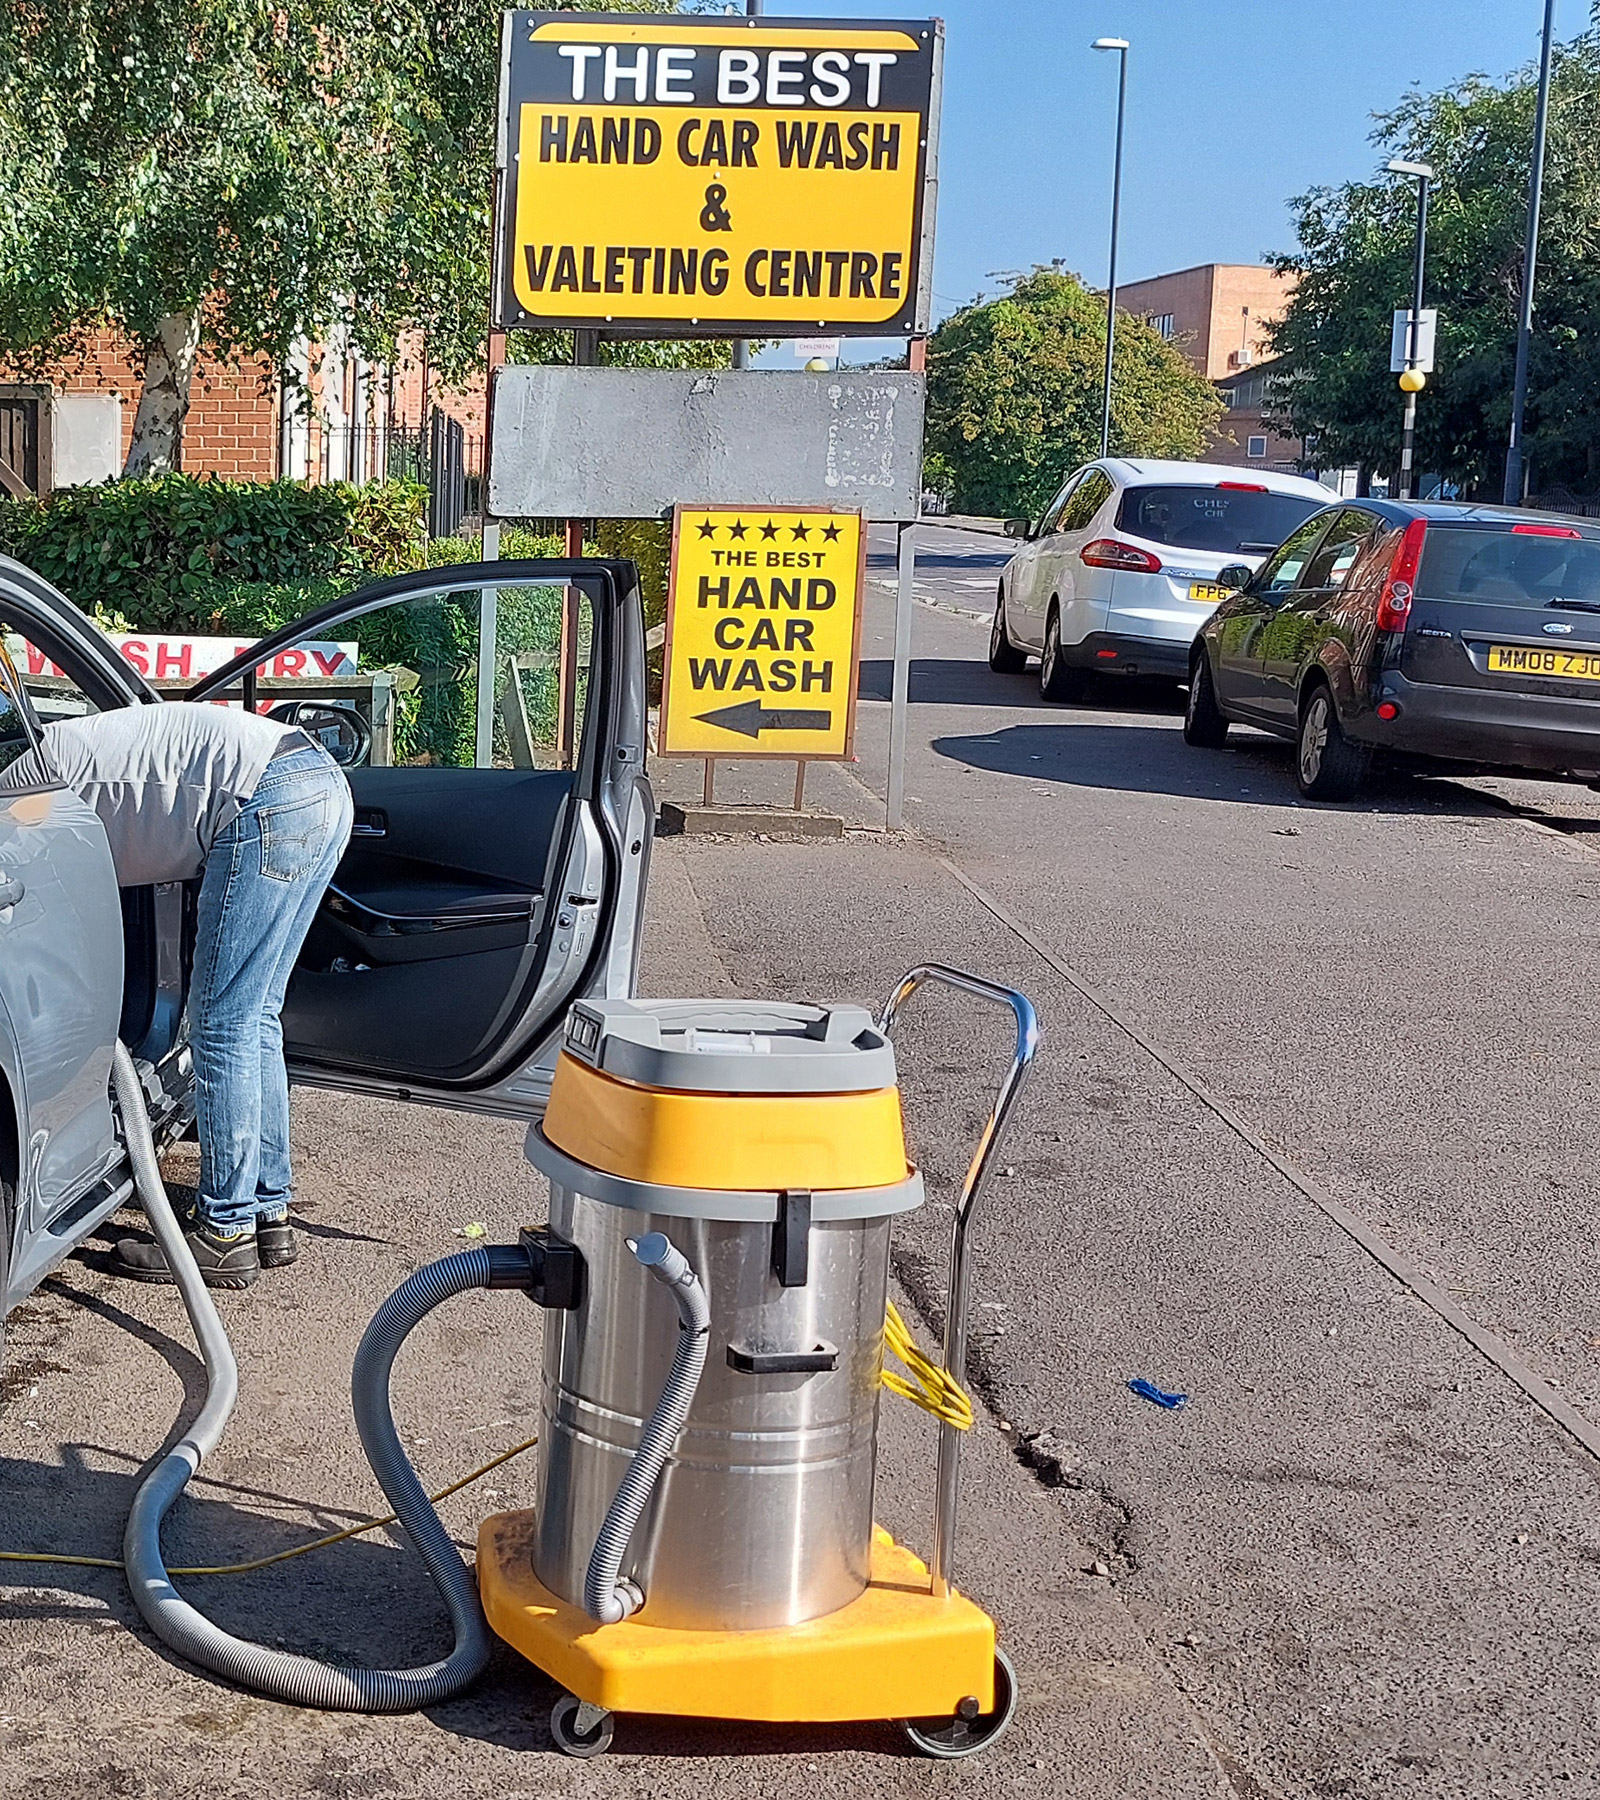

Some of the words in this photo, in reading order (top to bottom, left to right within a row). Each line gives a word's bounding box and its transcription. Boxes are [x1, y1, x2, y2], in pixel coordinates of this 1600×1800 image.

[558, 45, 698, 103] THE
[717, 48, 898, 108] BEST
[539, 114, 662, 166] HAND
[677, 118, 760, 168] CAR
[777, 120, 900, 171] WASH
[699, 183, 733, 233] &
[524, 245, 729, 297] VALETING
[744, 249, 902, 299] CENTRE
[711, 550, 757, 567] THE
[765, 551, 826, 568] BEST
[697, 575, 837, 611] HAND
[1196, 584, 1227, 600] FP6
[714, 617, 815, 652] CAR
[688, 657, 834, 693] WASH
[1499, 649, 1555, 671] MM08
